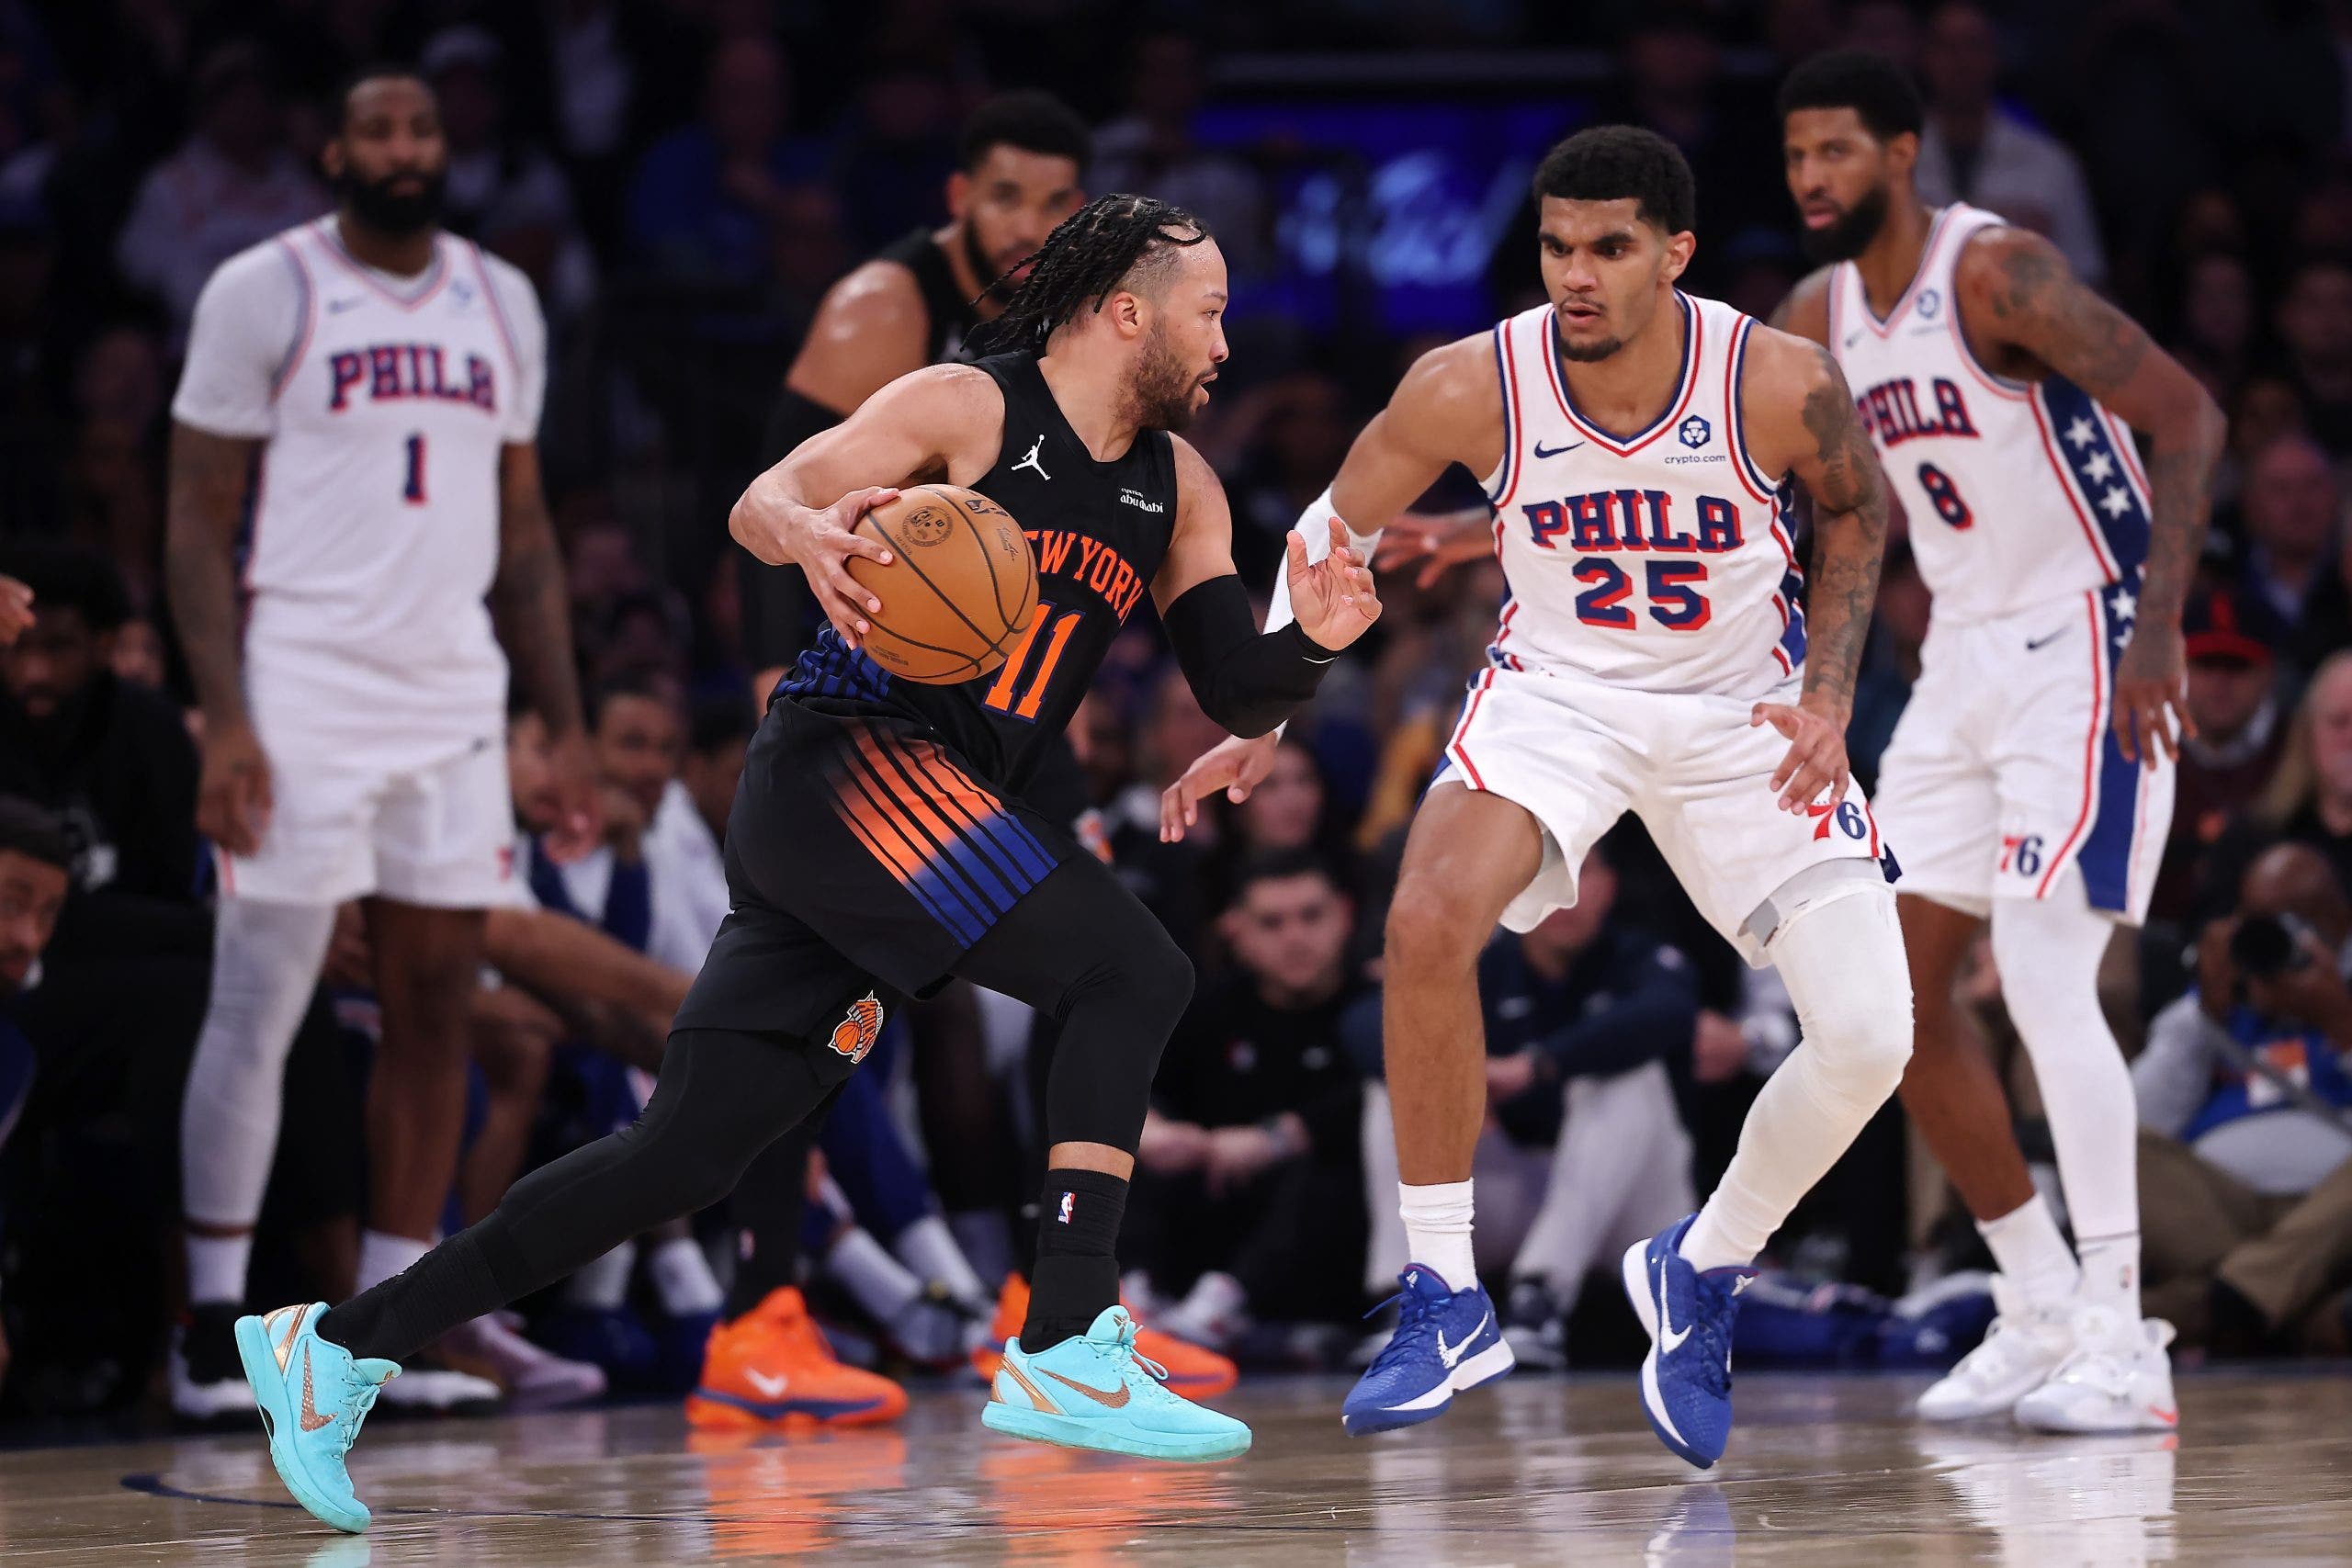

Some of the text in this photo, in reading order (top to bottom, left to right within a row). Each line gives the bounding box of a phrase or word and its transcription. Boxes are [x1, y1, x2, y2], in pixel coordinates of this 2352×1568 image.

[329, 344, 498, 414] PHILA
[404, 433, 426, 503] 1
[1664, 455, 1726, 465] crypto.com
[1120, 494, 1139, 507] abu
[1521, 489, 1745, 553] PHILA
[1918, 461, 1973, 530] 8
[1073, 536, 1144, 620] YORK
[1572, 557, 1712, 631] 25
[981, 599, 1086, 724] 11
[1807, 801, 1867, 840] 76
[2000, 834, 2043, 875] 76
